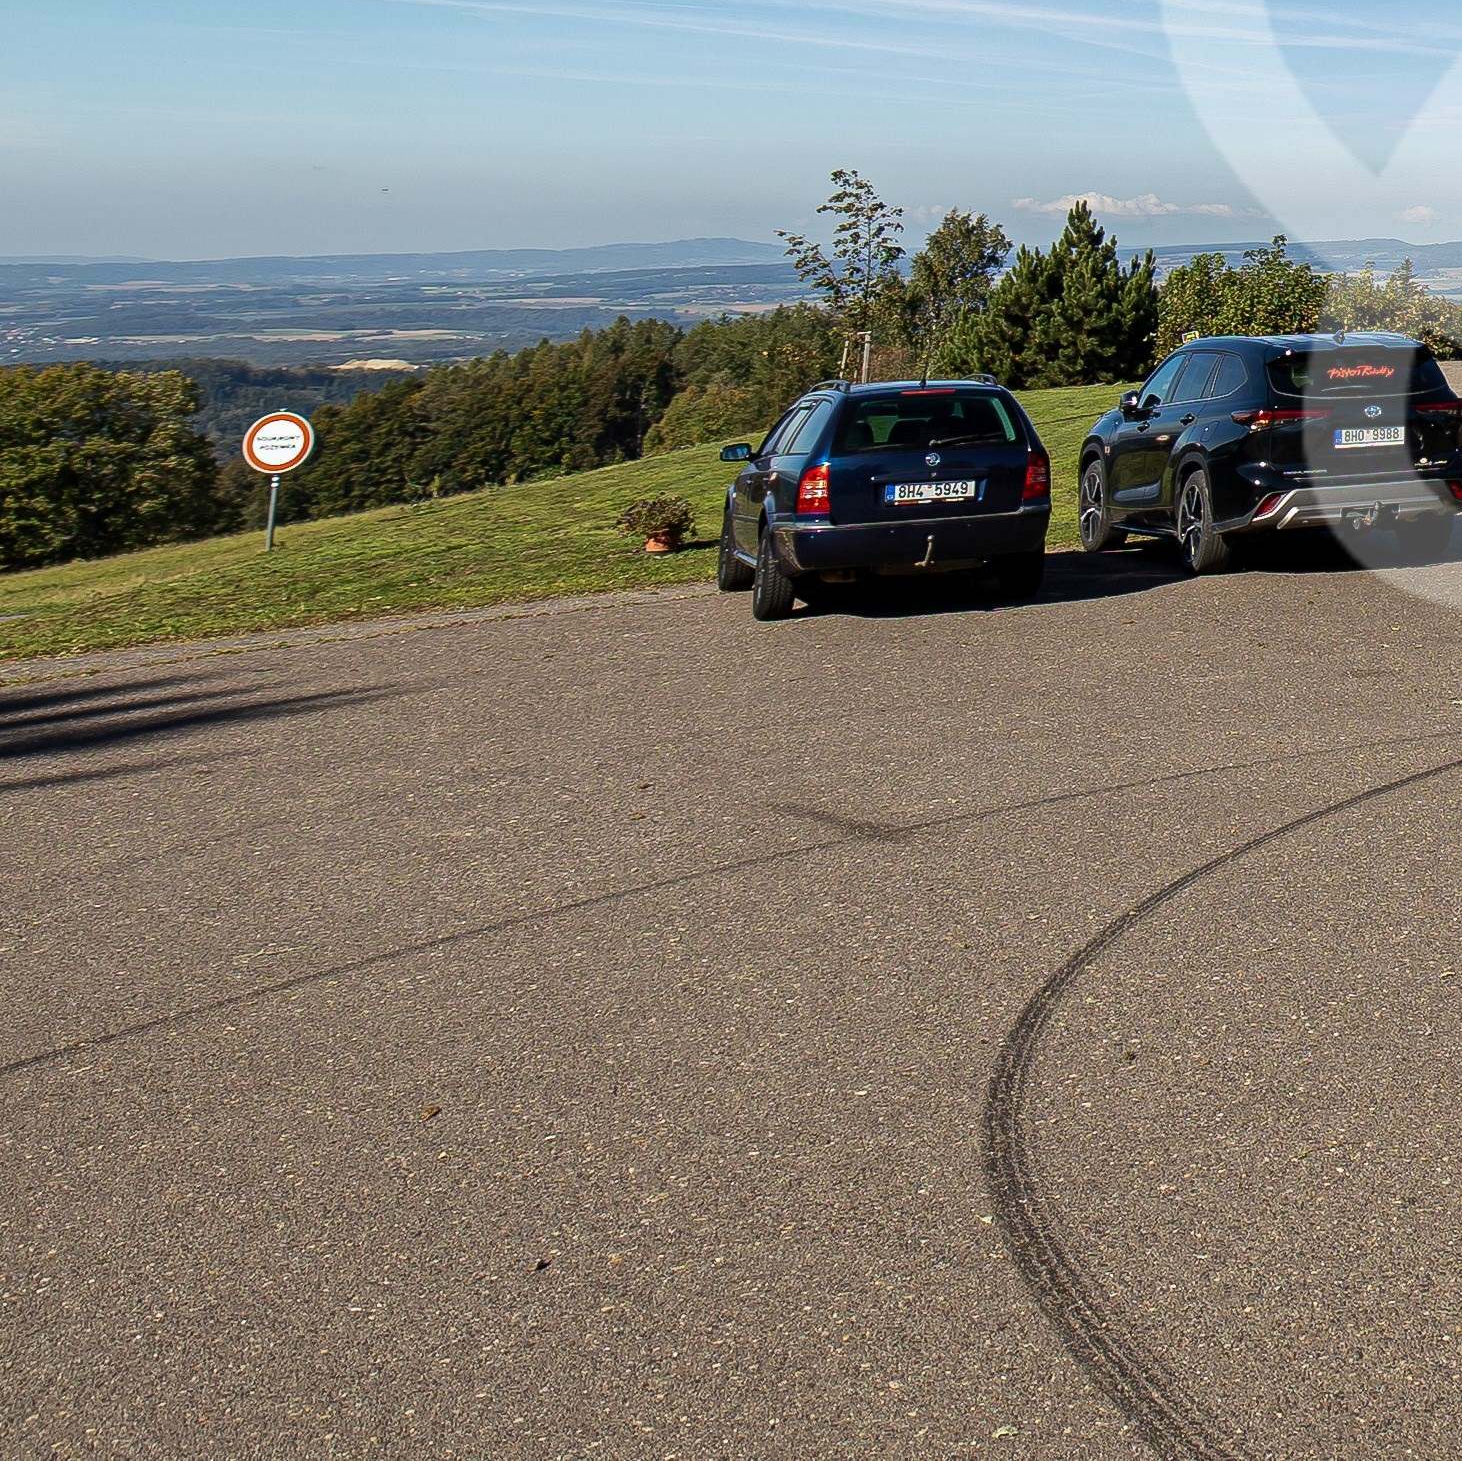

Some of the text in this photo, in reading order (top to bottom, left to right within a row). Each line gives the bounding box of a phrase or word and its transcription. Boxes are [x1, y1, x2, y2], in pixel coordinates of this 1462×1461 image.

[1372, 428, 1400, 440] 9988
[899, 481, 969, 498] 8H4 5949
